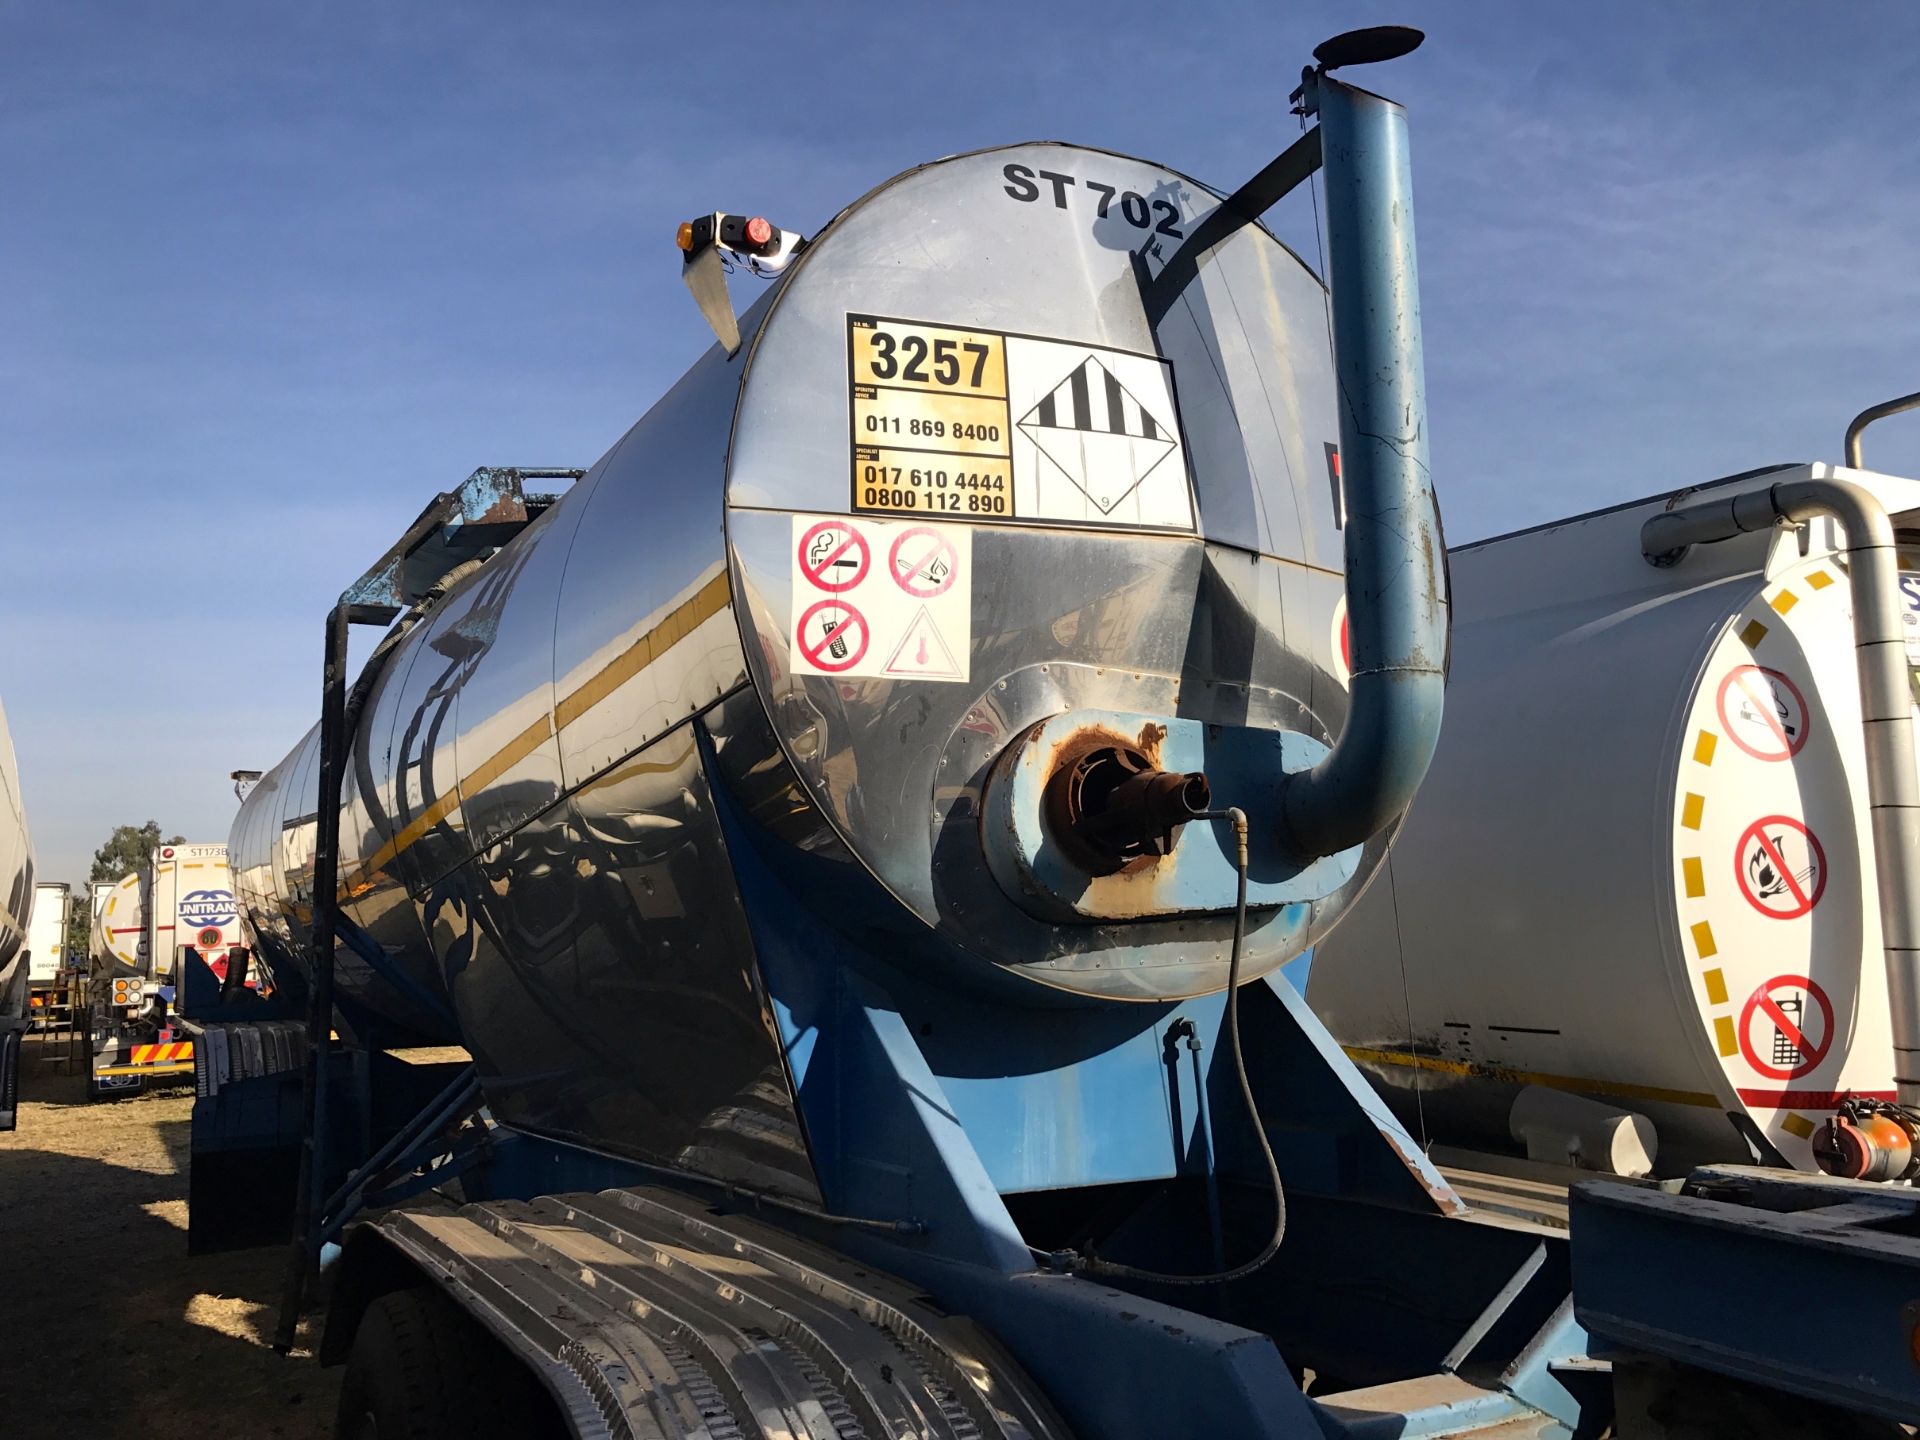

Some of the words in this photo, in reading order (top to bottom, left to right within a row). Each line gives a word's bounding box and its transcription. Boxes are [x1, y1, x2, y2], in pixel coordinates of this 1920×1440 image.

[1003, 164, 1075, 210] ST
[1086, 181, 1183, 240] 702
[870, 332, 989, 388] 3257
[866, 415, 900, 434] 011
[910, 419, 945, 437] 869
[953, 422, 999, 442] 8400
[865, 465, 902, 485] 017
[911, 469, 948, 488] 610
[955, 472, 1004, 492] 4444
[865, 487, 916, 508] 0800
[924, 491, 961, 510] 112
[968, 494, 1005, 513] 890
[1101, 496, 1110, 508] 9
